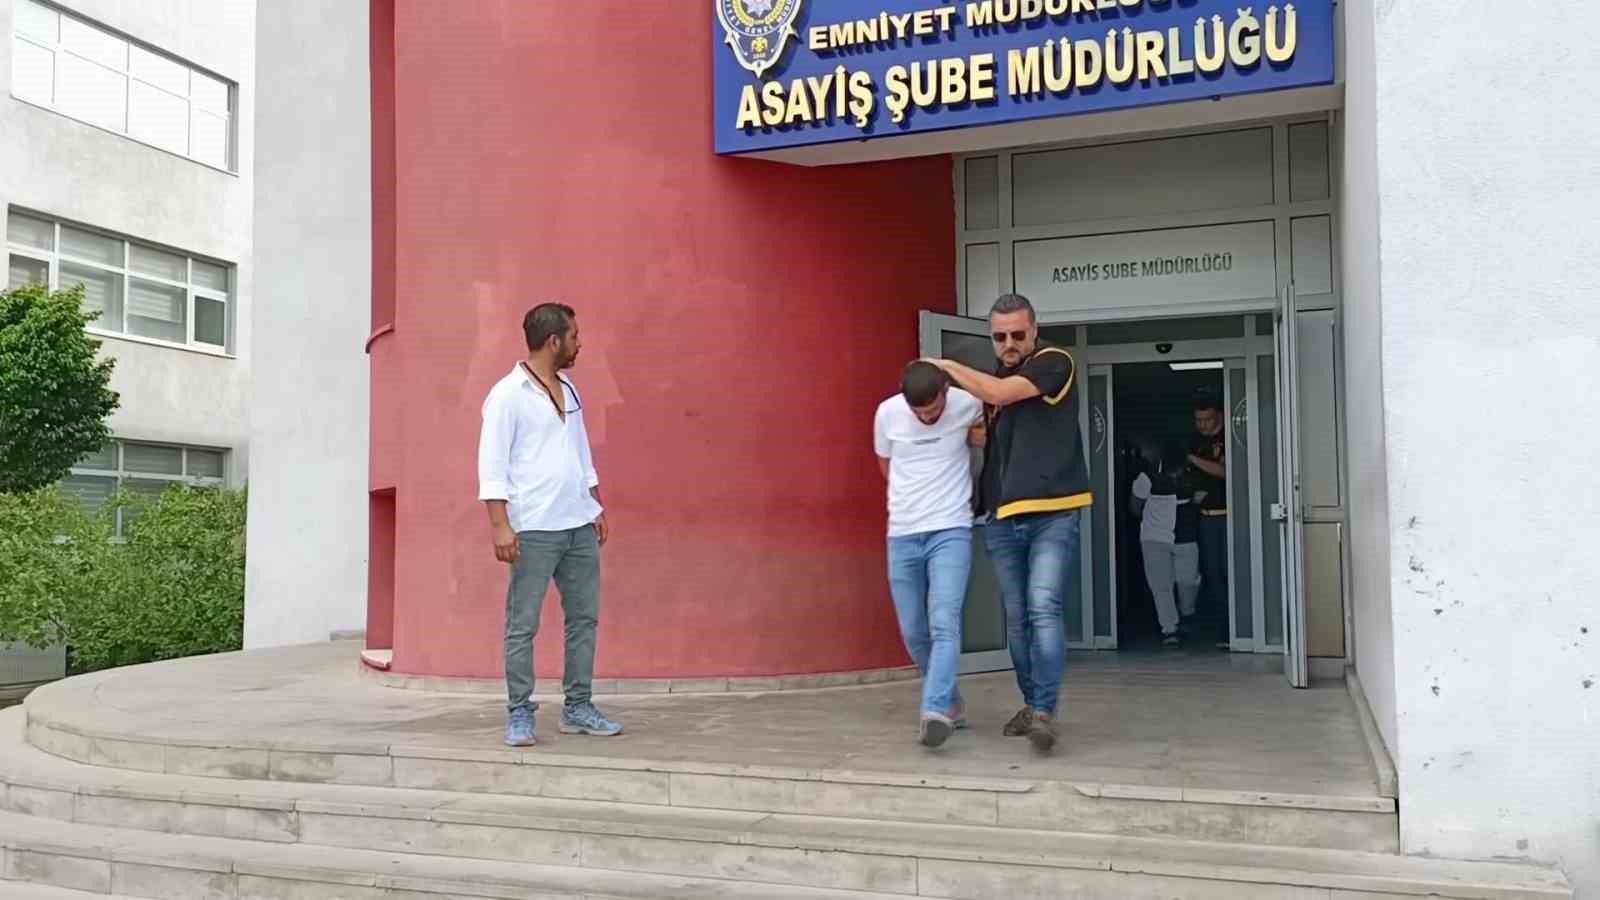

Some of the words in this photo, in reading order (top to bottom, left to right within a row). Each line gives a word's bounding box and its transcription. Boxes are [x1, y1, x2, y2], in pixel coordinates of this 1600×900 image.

[809, 7, 956, 50] EMNİYET
[966, 0, 1168, 27] MÜDÜR
[736, 64, 874, 129] ASAYİŞ
[885, 53, 994, 122] ŞUBE
[1007, 3, 1297, 96] MÜDÜRLÜĞÜ
[1142, 252, 1233, 277] MÜDÜRLÜĞÜ
